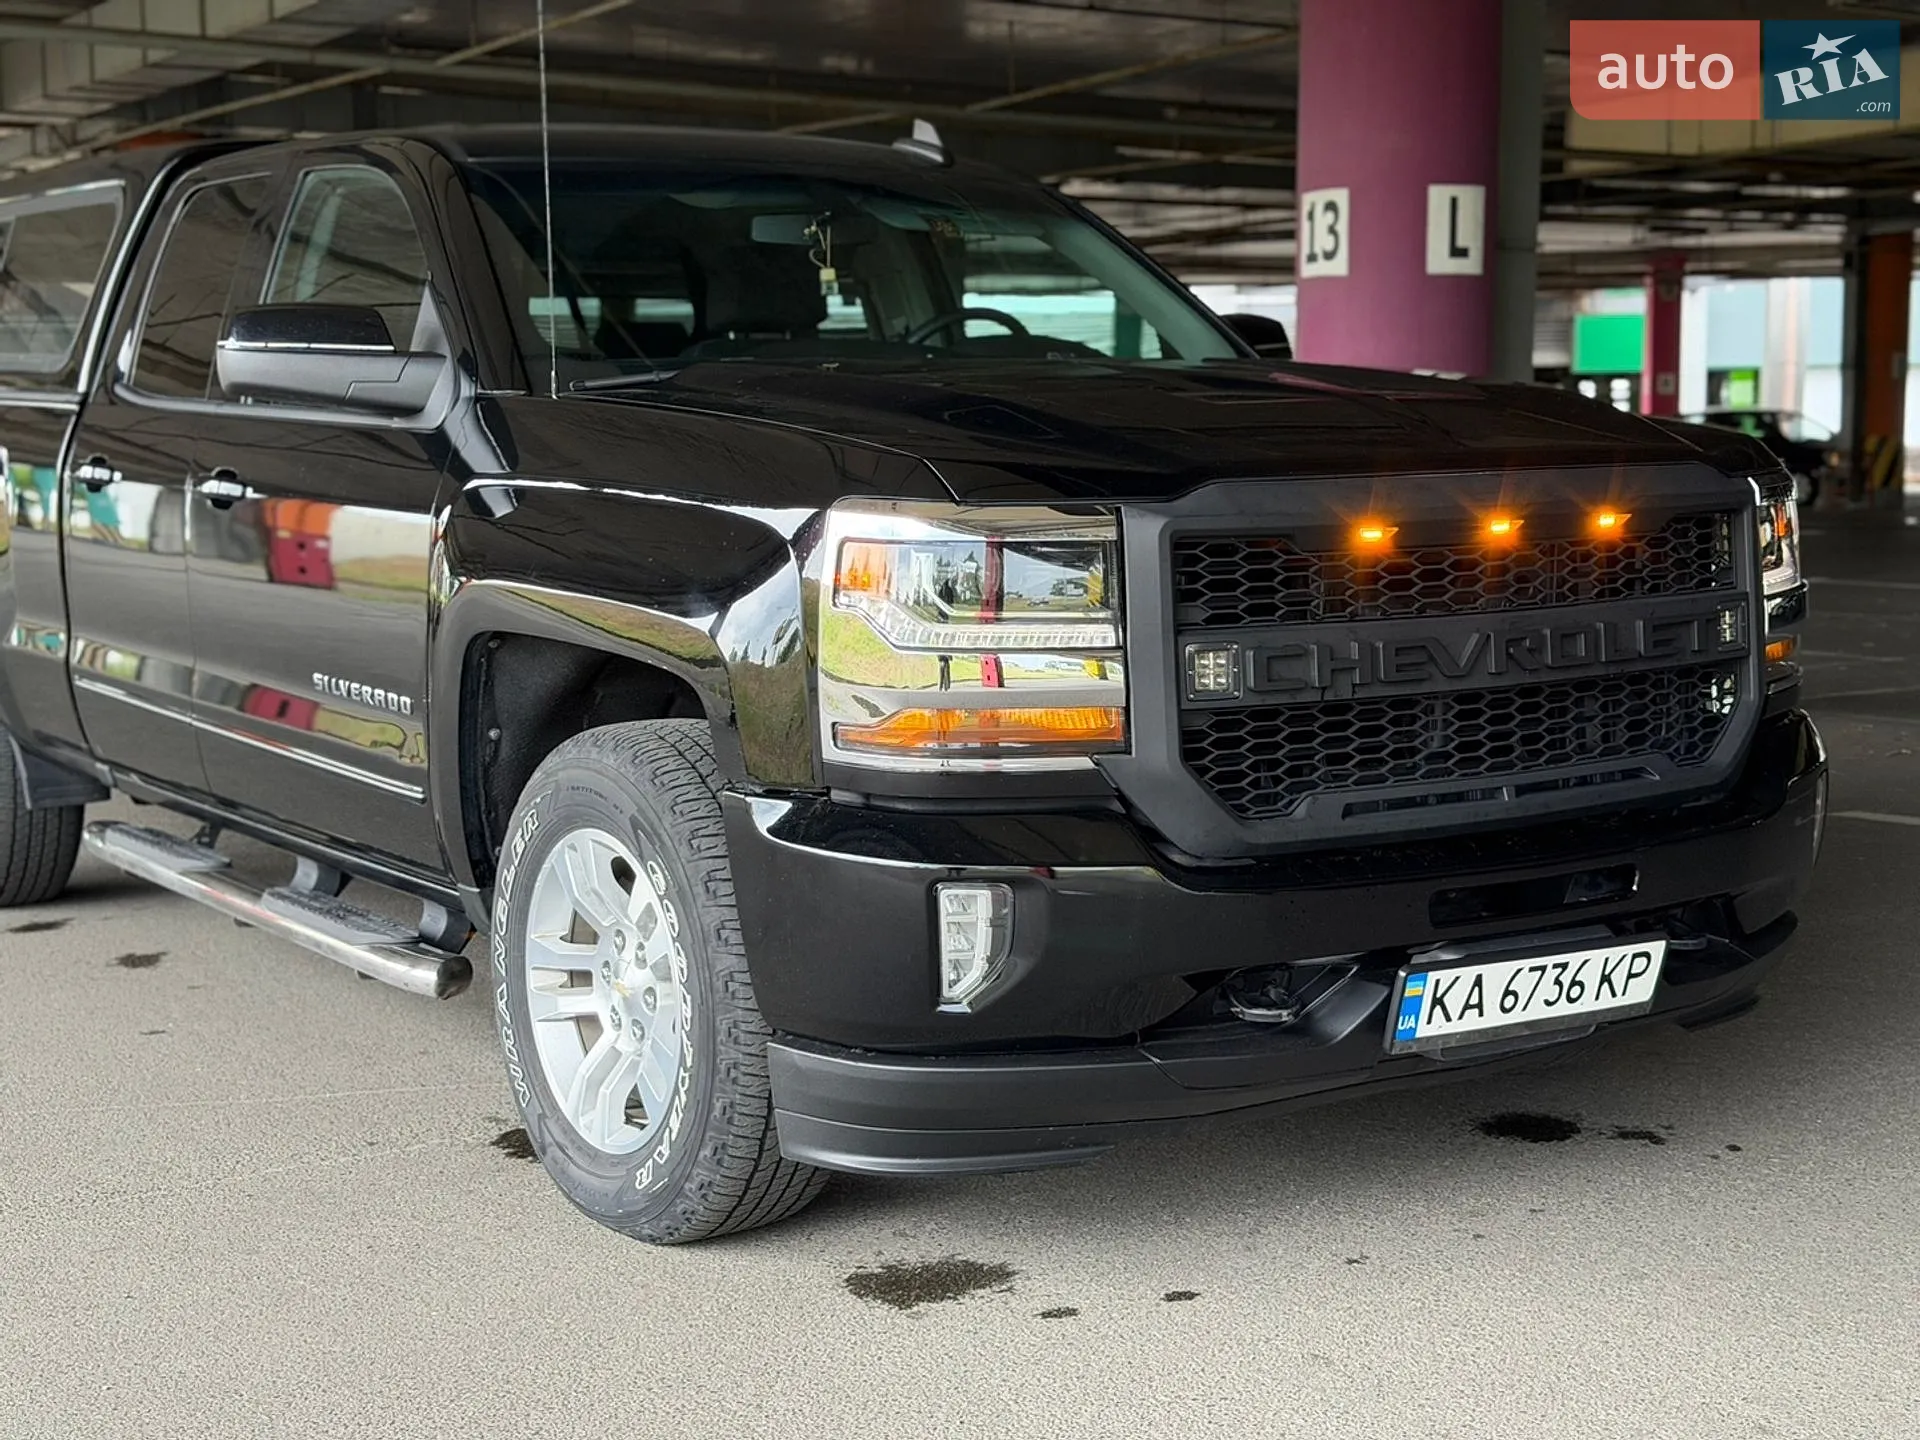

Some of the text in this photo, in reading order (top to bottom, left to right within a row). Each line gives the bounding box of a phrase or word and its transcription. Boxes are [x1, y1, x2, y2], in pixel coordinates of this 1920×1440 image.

[1306, 199, 1340, 264] 13
[1448, 196, 1470, 258] L
[1246, 616, 1719, 692] CHEVROLET
[312, 672, 412, 715] SILVERADO
[495, 809, 540, 1108] WRANGLER
[1426, 951, 1651, 1025] KA 6736 KP
[635, 861, 693, 1189] GOODYEAR
[1398, 1016, 1416, 1031] UA
